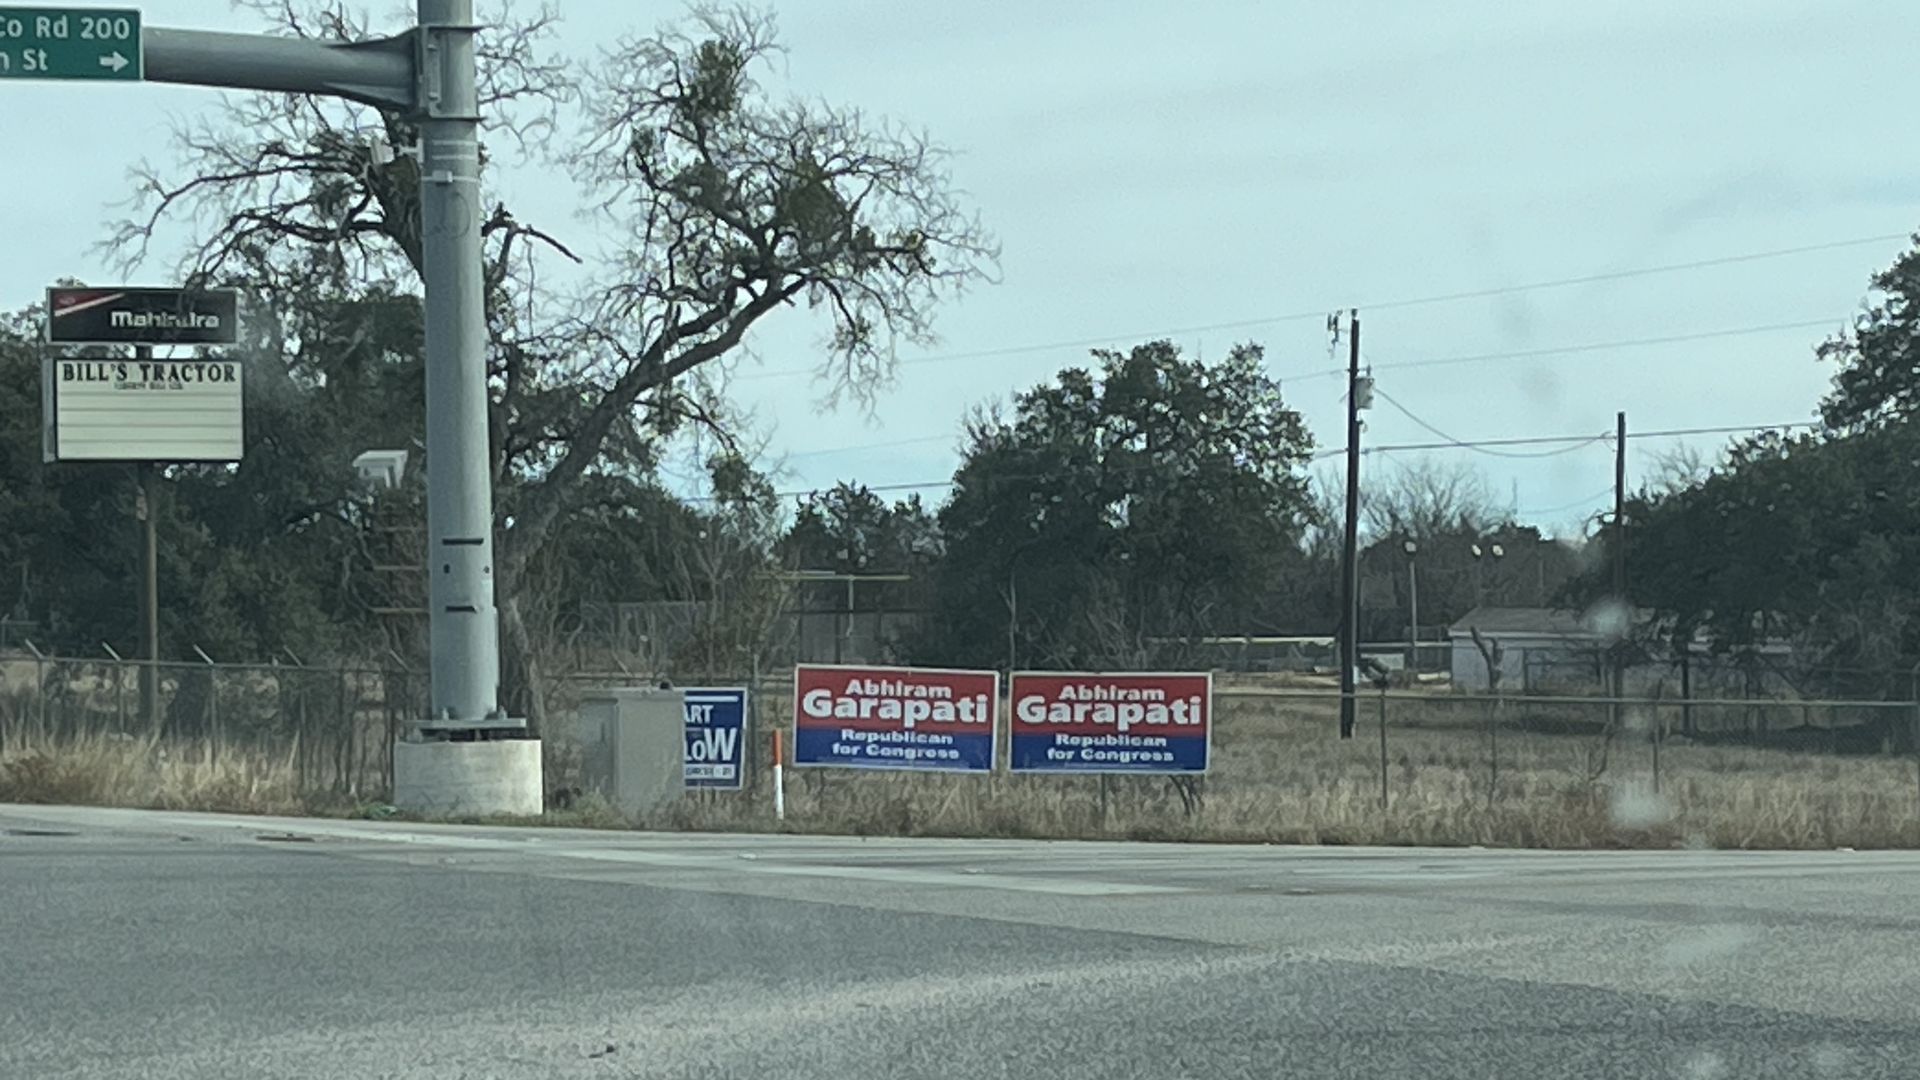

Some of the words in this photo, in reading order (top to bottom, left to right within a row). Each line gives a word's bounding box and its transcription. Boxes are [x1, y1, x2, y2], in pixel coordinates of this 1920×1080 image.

[36, 16, 69, 38] Rd
[80, 18, 130, 39] 200
[23, 48, 48, 71] St
[63, 363, 128, 381] BILL'S
[140, 363, 236, 382] TRACTOR
[845, 679, 952, 698] Abhiram
[1058, 685, 1165, 701] Abhiram
[803, 688, 989, 728] Garapati
[1016, 695, 1202, 731] Garapati
[841, 729, 954, 745] Republican
[1055, 733, 1167, 748] Republican
[832, 743, 861, 756] for
[866, 745, 960, 760] Congress
[1047, 748, 1076, 760] for
[1081, 749, 1174, 763] Congress
